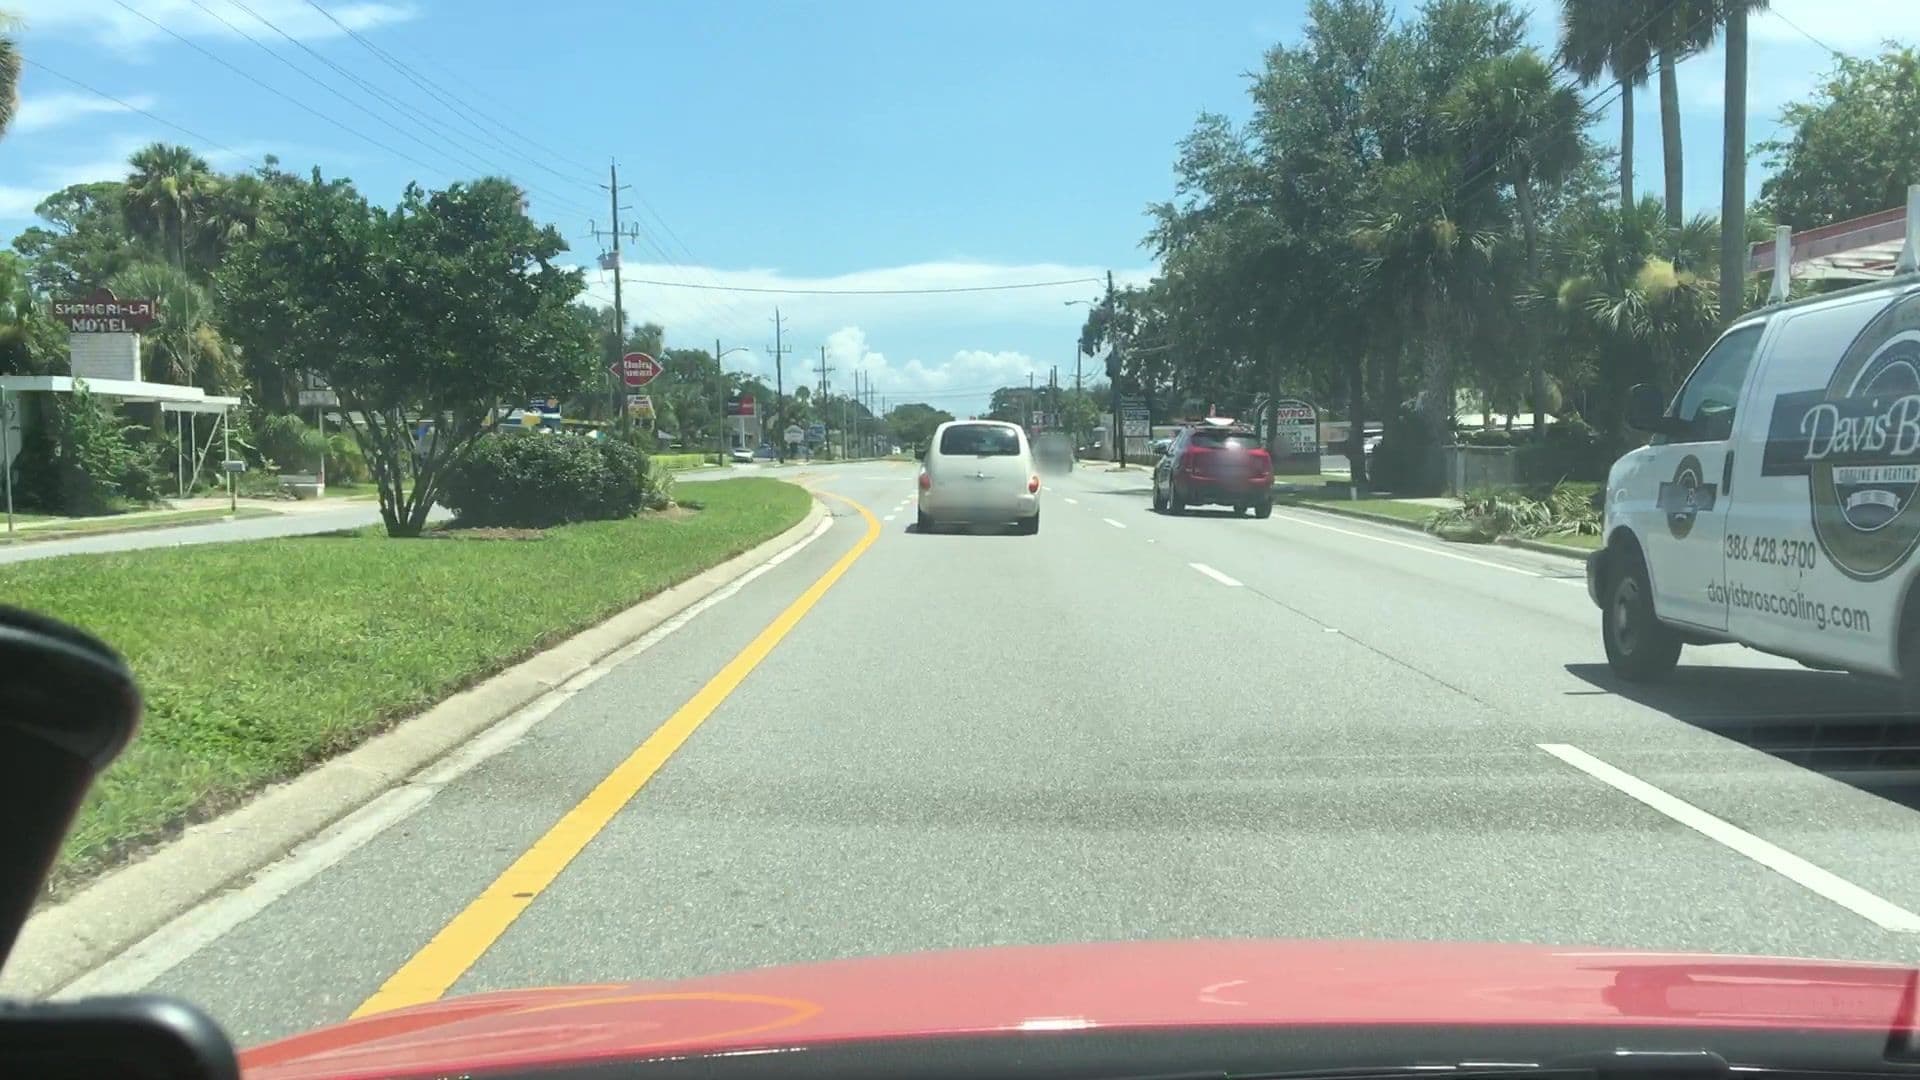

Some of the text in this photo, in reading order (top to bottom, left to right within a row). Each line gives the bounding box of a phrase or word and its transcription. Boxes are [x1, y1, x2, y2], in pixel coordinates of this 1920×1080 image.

[72, 318, 133, 332] MOTEL
[1800, 394, 1920, 460] Davis B
[1883, 467, 1918, 481] HEATING
[1726, 534, 1817, 570] 386.428.3700
[1707, 582, 1870, 633] davisbroscooling.com
